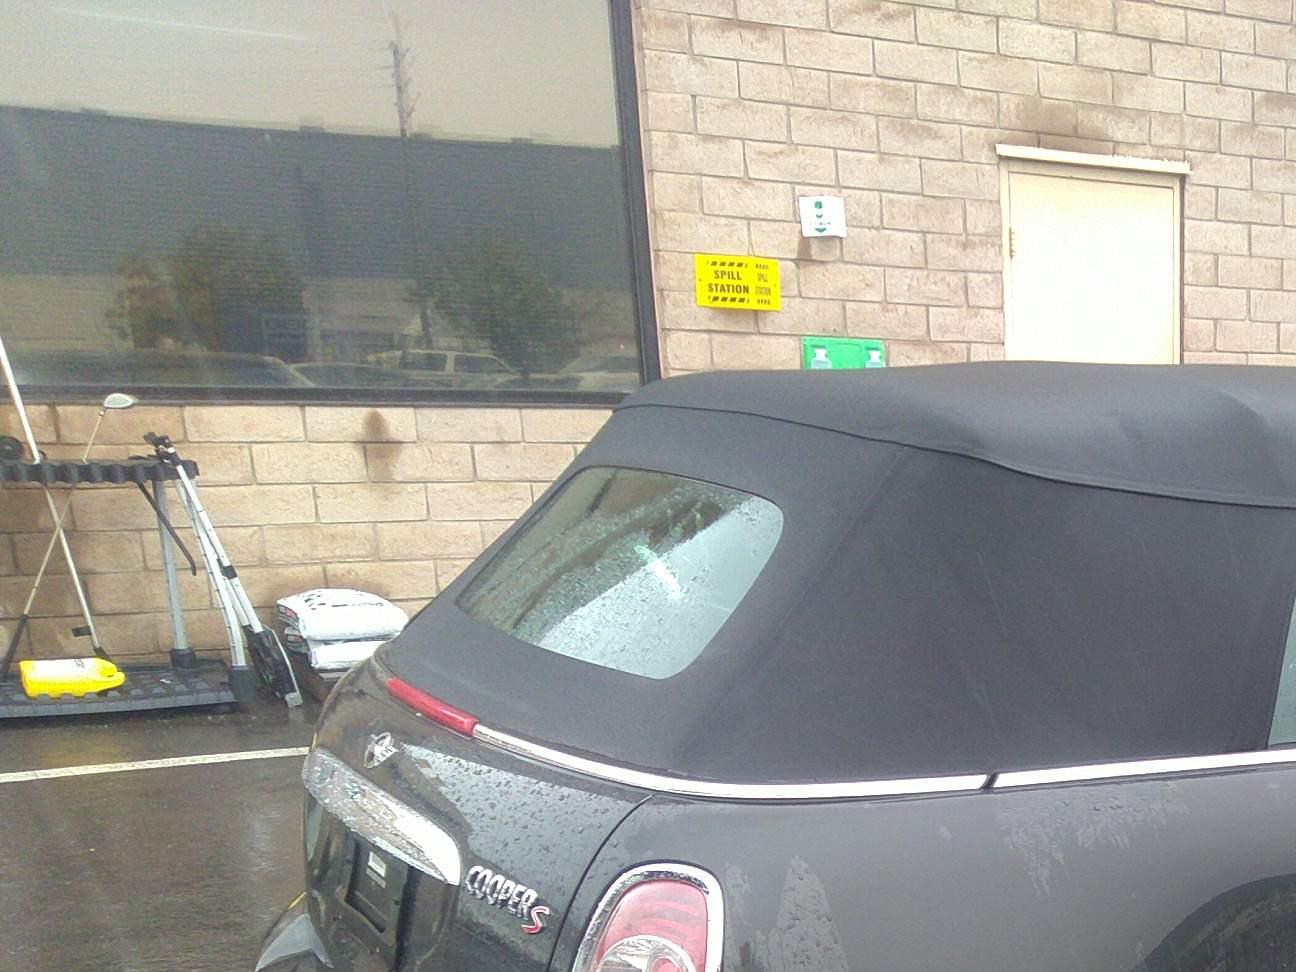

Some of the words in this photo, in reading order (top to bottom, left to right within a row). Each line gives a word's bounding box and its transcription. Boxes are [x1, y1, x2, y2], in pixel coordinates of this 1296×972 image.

[714, 270, 742, 280] SPILL
[708, 283, 749, 294] STATION
[465, 865, 538, 921] COOPER
[521, 905, 550, 934] S
